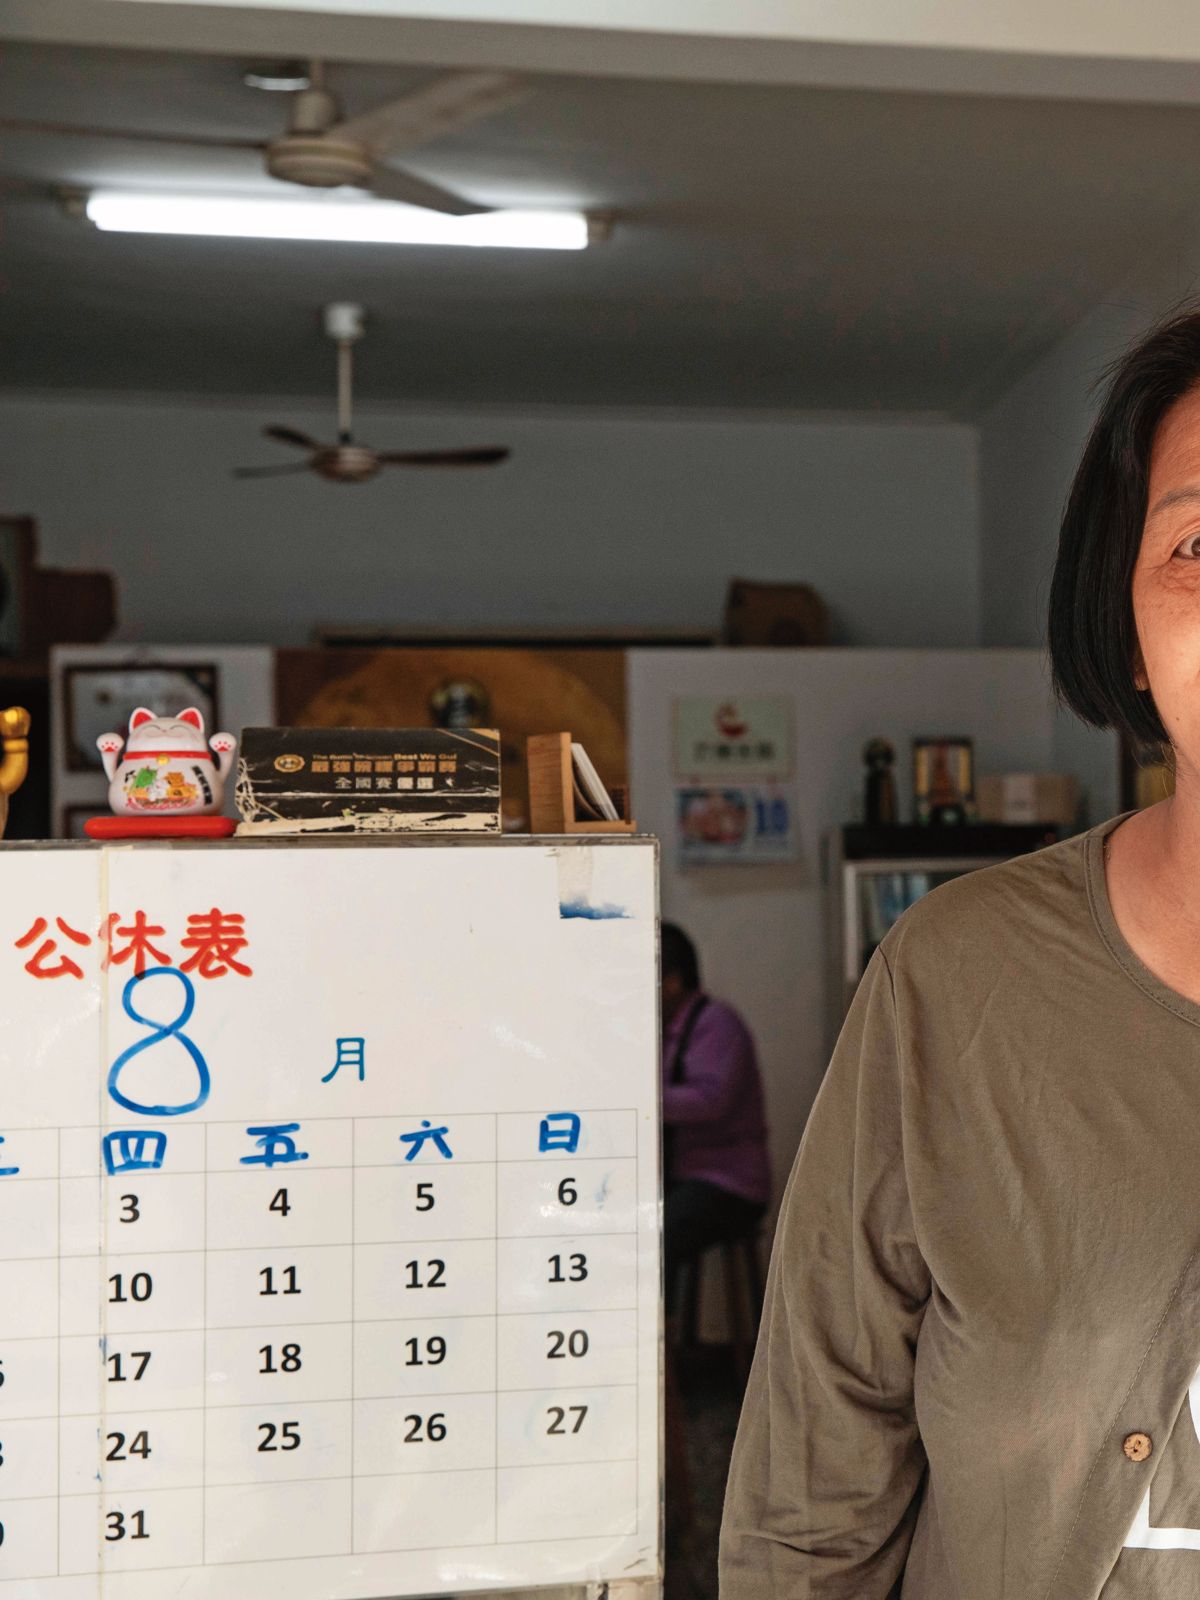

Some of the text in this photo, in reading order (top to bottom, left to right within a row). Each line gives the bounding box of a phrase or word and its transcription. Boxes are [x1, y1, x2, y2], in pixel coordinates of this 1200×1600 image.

[14, 907, 253, 980] 公休表
[108, 966, 211, 1117] 8
[322, 1037, 366, 1083] 月
[103, 1112, 582, 1176] 四 五 六 日
[118, 1177, 579, 1223] 3 4 5 6
[107, 1253, 589, 1303] 10 11 12 13
[106, 1329, 590, 1382] 17 18 19 20
[105, 1405, 590, 1461] 24 25 26 27
[104, 1509, 151, 1541] 31
